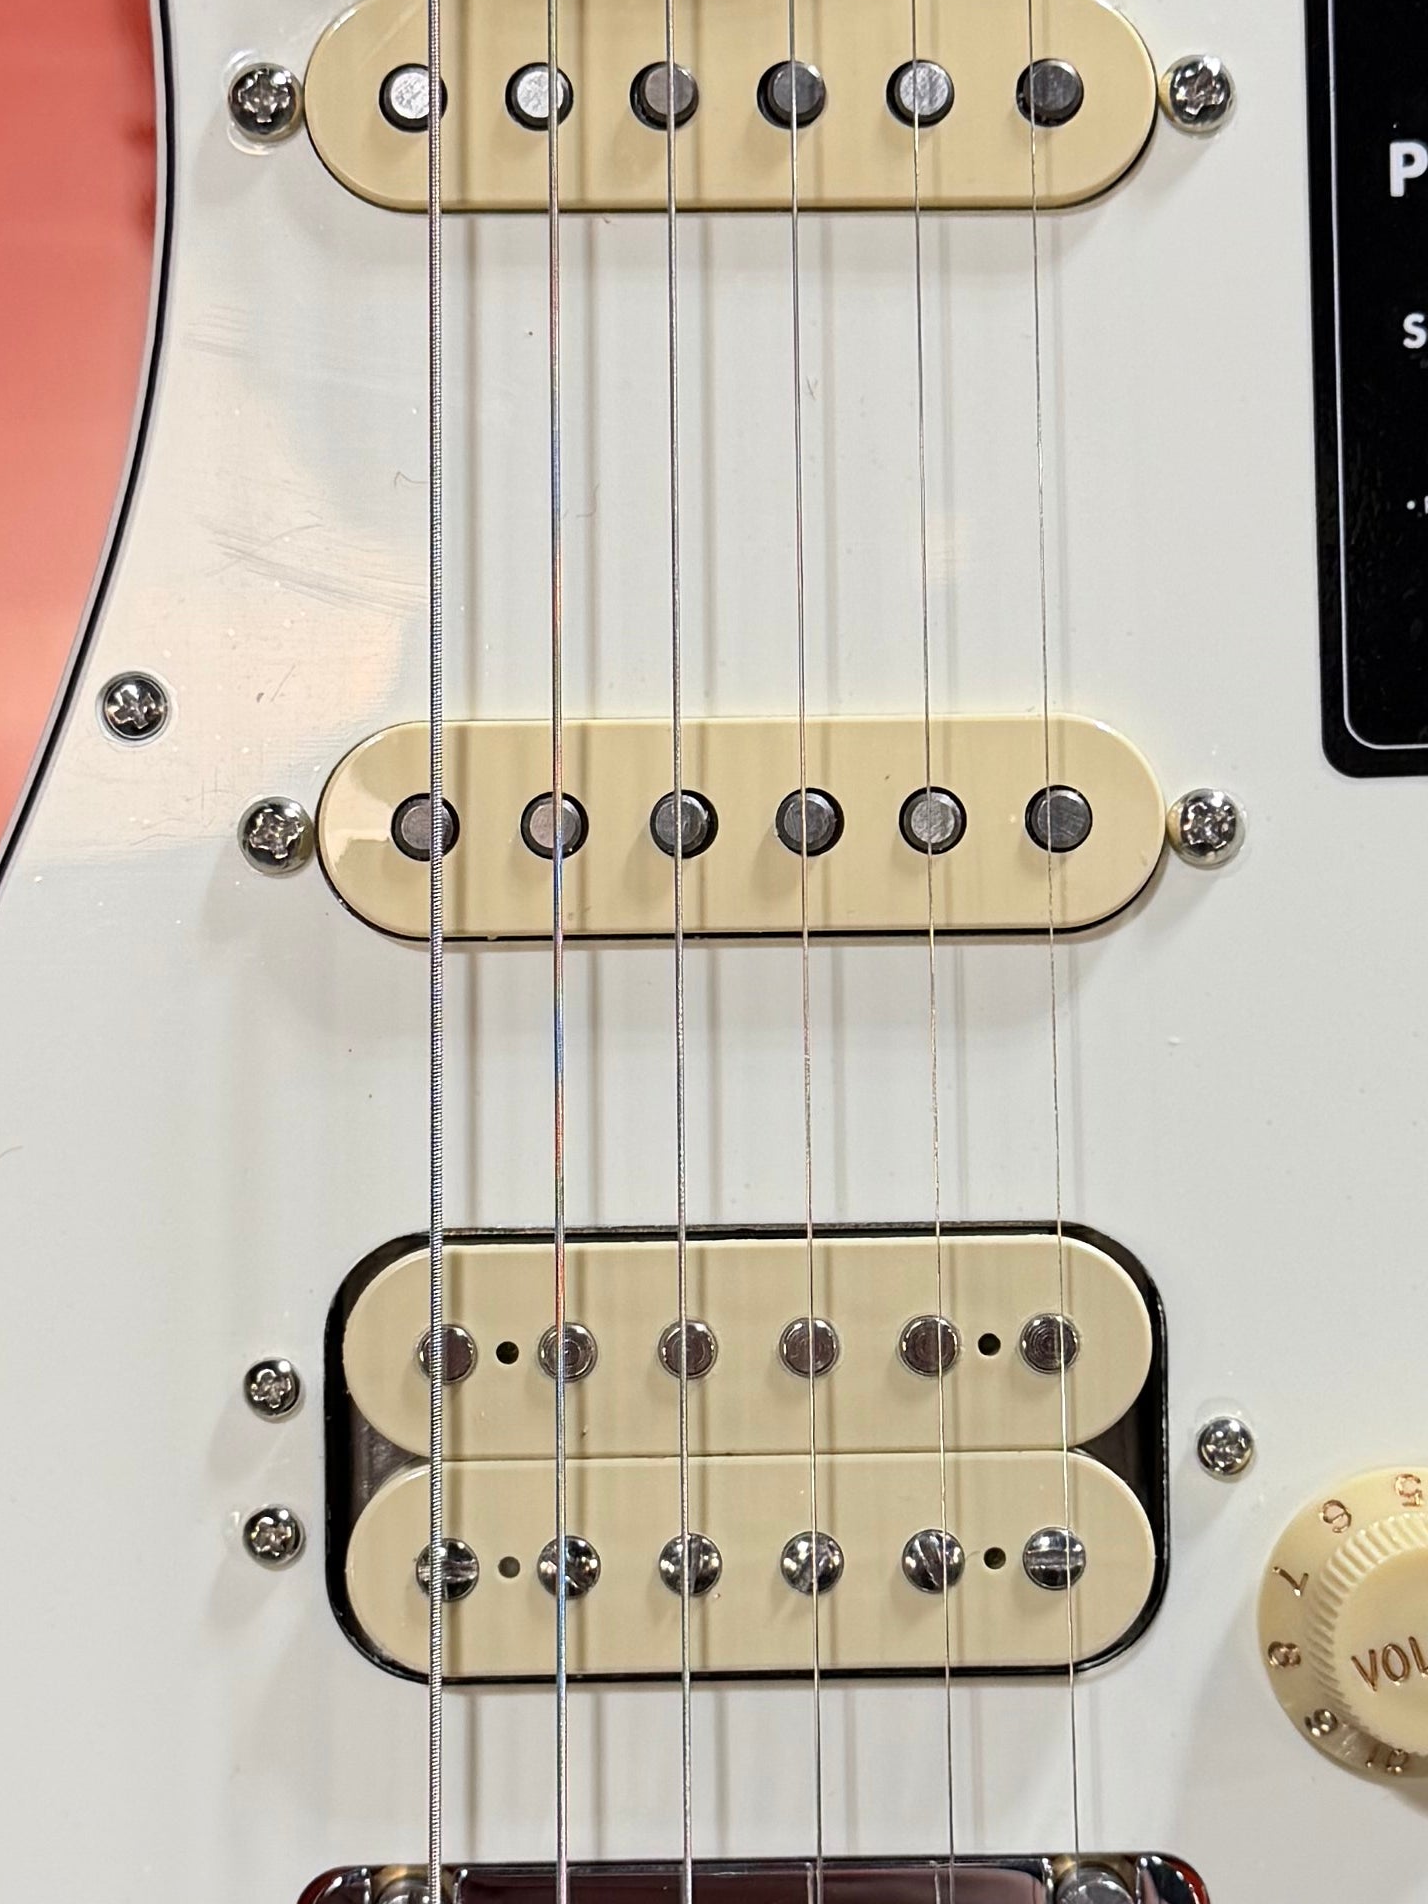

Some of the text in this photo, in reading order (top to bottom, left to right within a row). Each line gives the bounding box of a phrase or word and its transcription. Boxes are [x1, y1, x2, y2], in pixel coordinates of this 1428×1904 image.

[1394, 1473, 1424, 1508] 5
[1273, 1566, 1309, 1597] 7
[1266, 1640, 1302, 1669] 8
